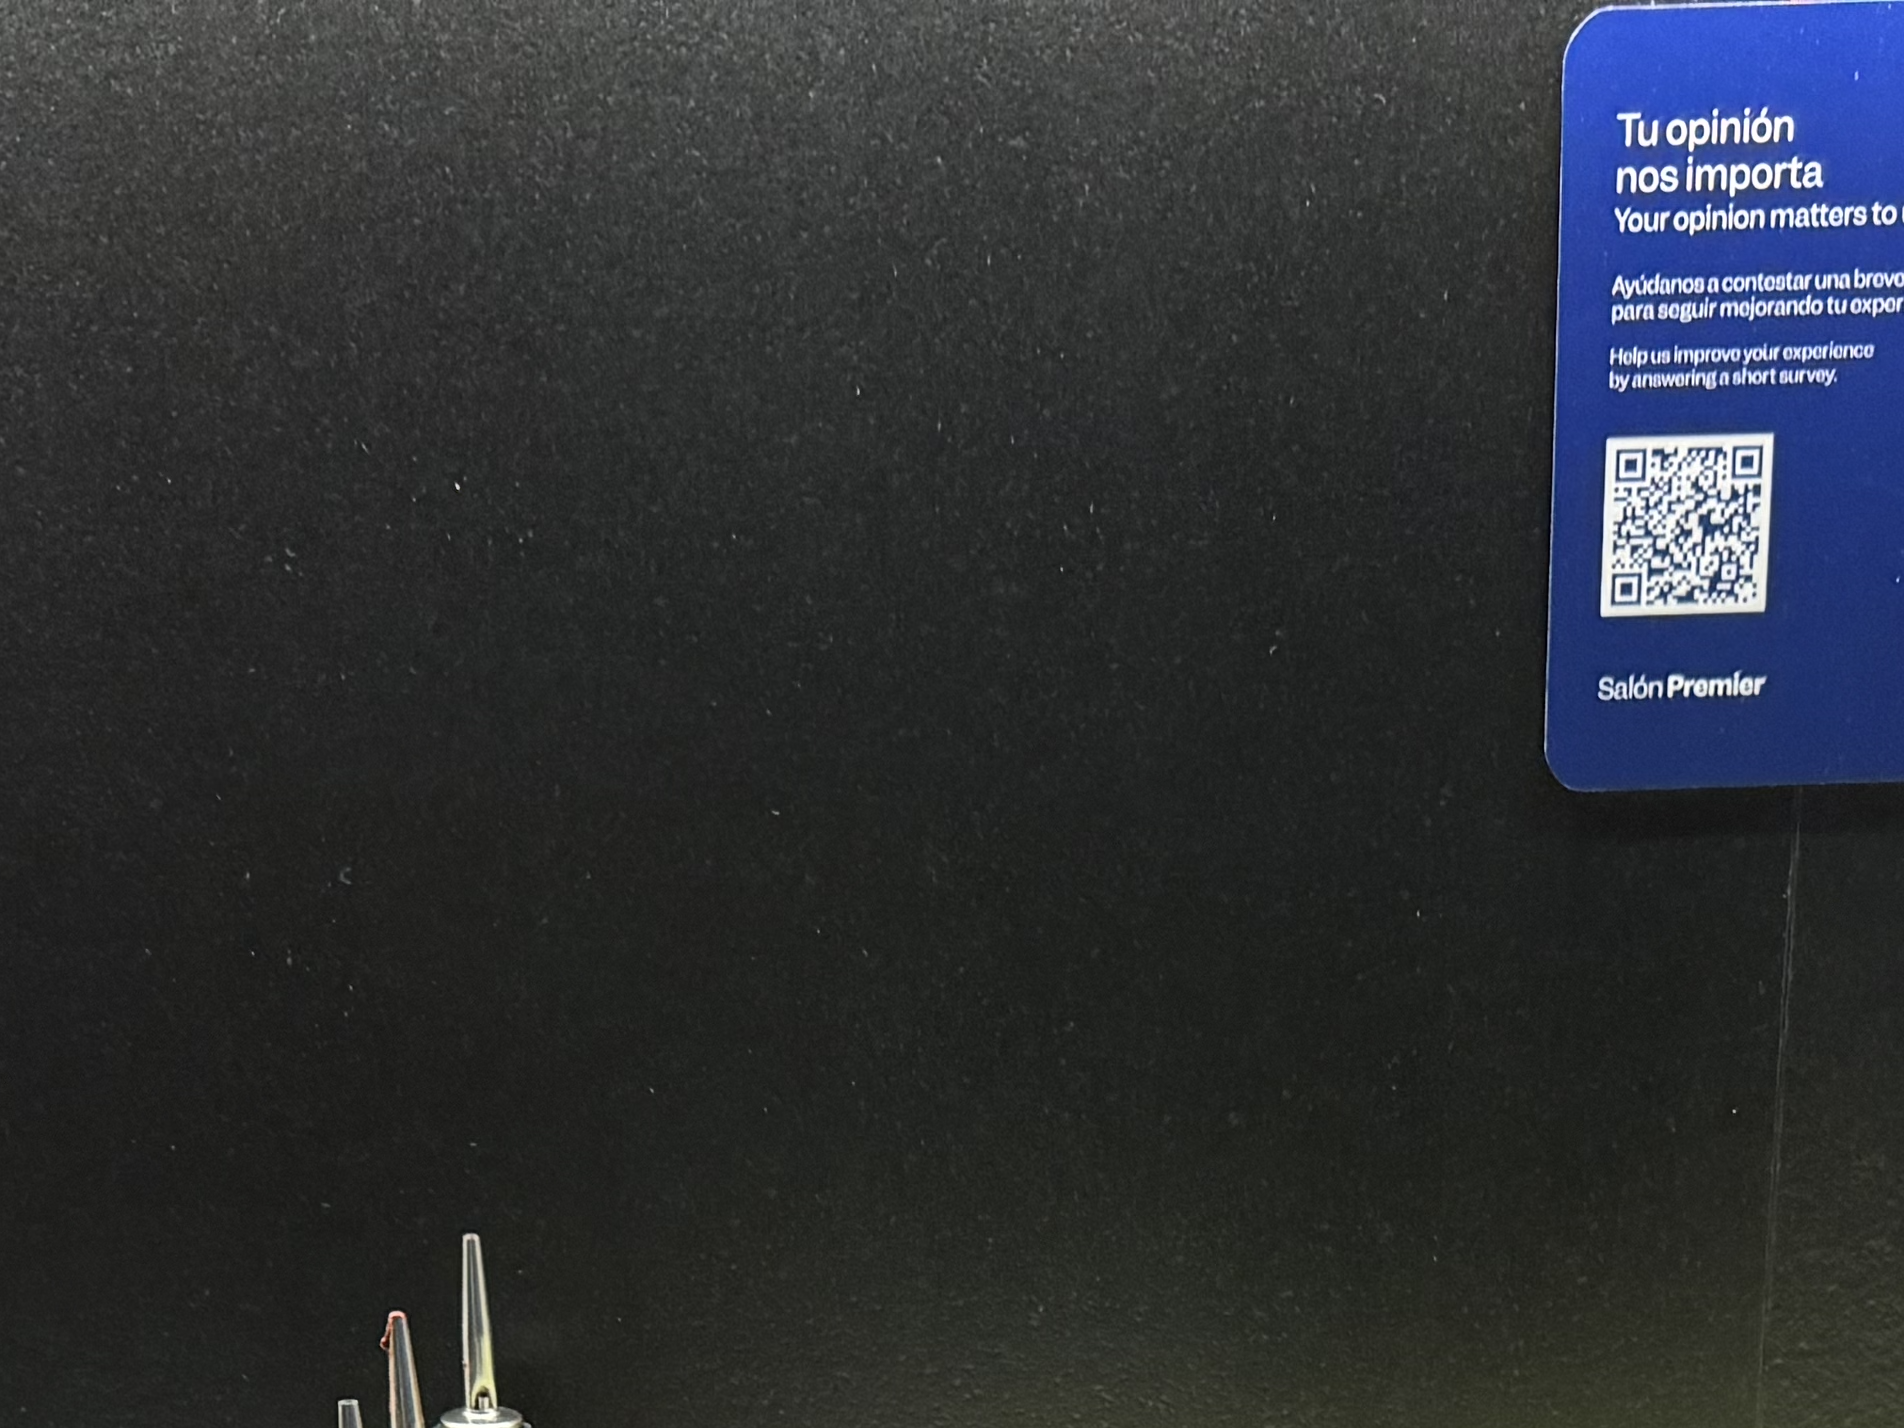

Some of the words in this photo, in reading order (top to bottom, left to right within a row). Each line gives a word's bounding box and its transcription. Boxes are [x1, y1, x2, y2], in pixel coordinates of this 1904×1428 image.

[1616, 112, 1659, 147] Tu
[1666, 106, 1795, 152] opinión
[1616, 166, 1679, 194] nos
[1686, 156, 1824, 198] importa
[1614, 207, 1671, 233] Your
[1673, 203, 1765, 236] opinion
[1770, 203, 1868, 229] matters
[1872, 201, 1898, 226] to
[1611, 273, 1705, 300] Ayúdanos
[1707, 277, 1719, 293] a
[1721, 272, 1812, 293] contestar
[1814, 272, 1850, 290] una
[1611, 303, 1654, 326] para
[1658, 296, 1717, 323] seguir
[1720, 293, 1824, 322] mejorando
[1827, 296, 1846, 315] tu
[1609, 346, 1648, 368] Help
[1650, 352, 1671, 365] us
[1673, 345, 1741, 366] improve
[1742, 343, 1779, 365] your
[1782, 340, 1876, 364] experience
[1609, 370, 1629, 392] by
[1631, 368, 1717, 390] answering
[1719, 372, 1729, 385] a
[1732, 368, 1776, 385] short
[1779, 367, 1838, 388] survey.
[1597, 673, 1664, 701] Salón
[1666, 669, 1768, 699] Premier
